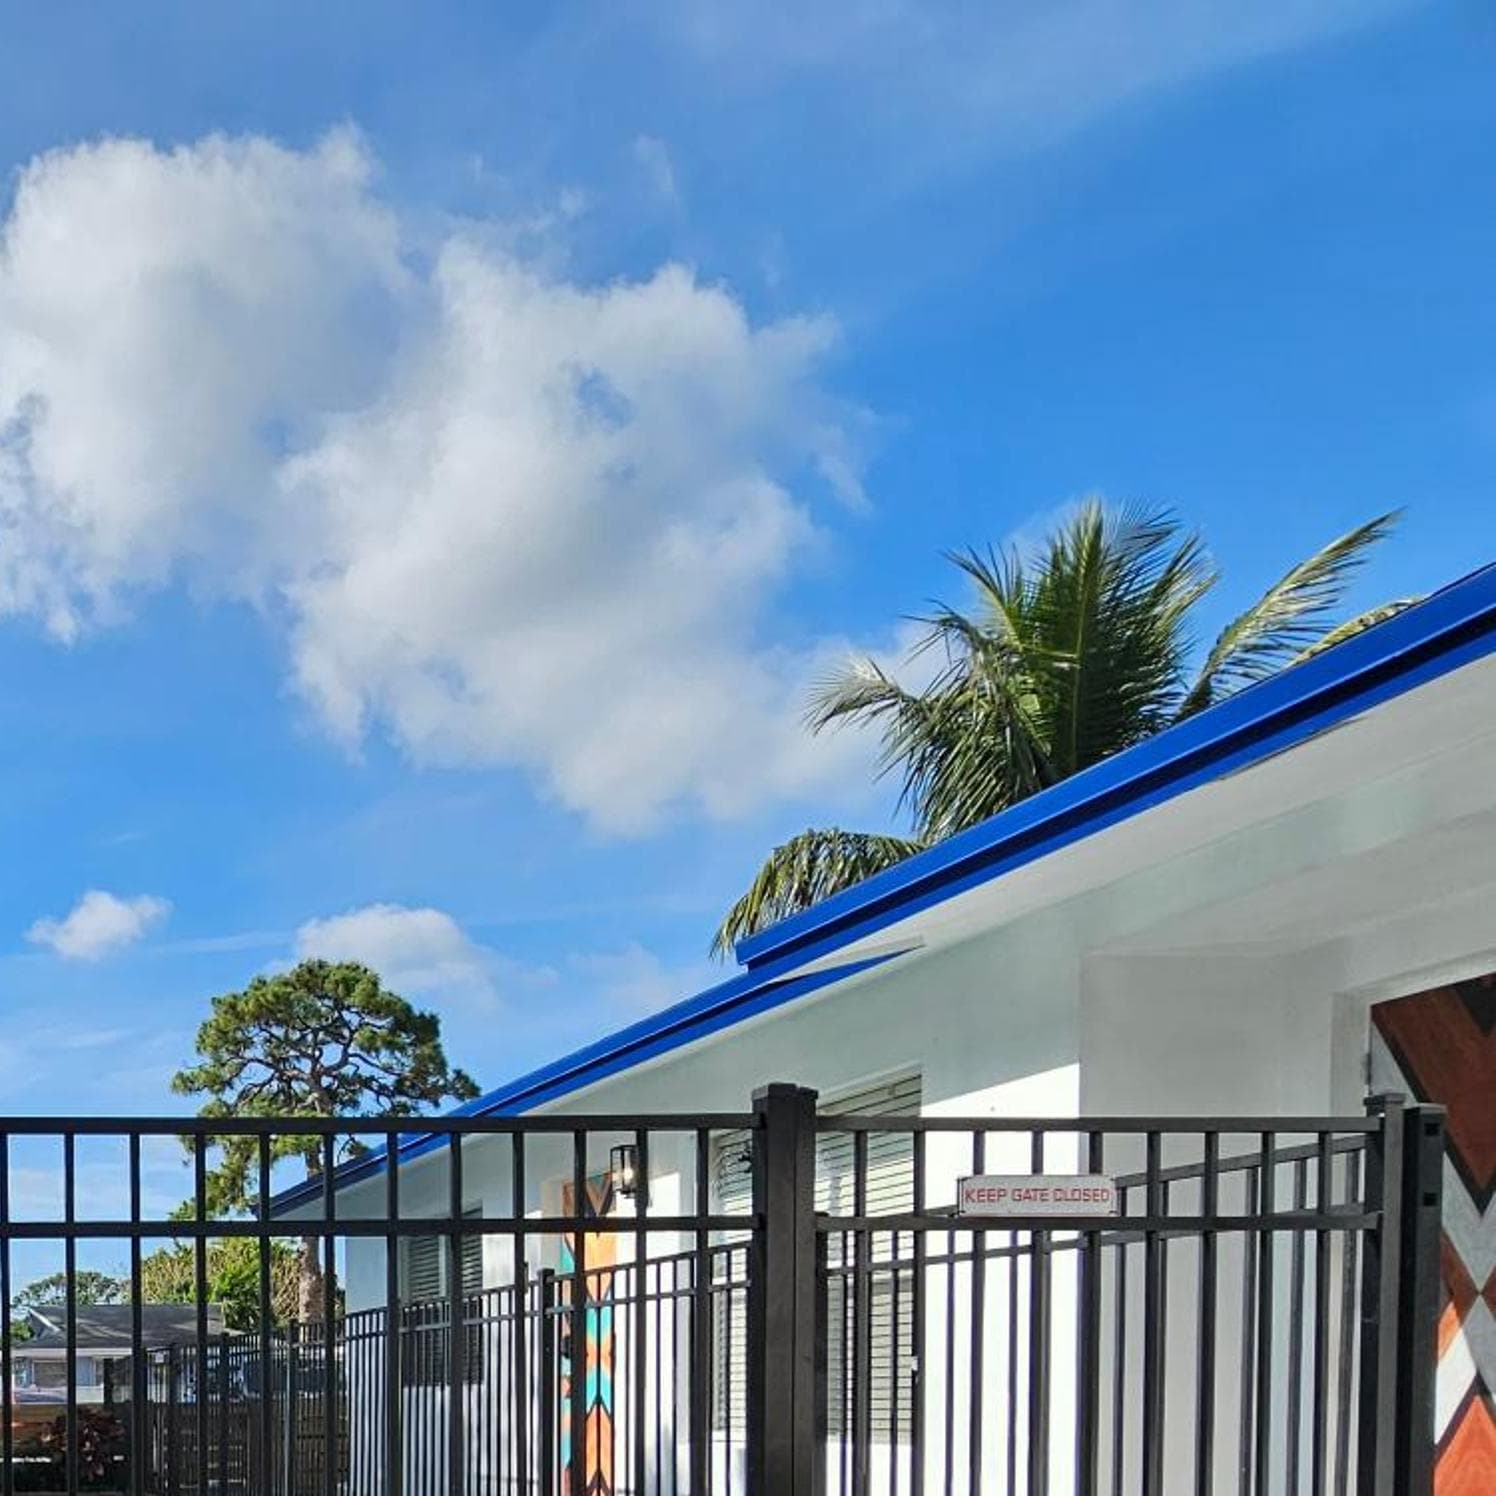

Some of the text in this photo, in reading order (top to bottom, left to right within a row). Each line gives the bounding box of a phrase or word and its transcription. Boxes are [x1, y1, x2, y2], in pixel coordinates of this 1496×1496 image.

[965, 1188, 1110, 1203] KEEP GATE CLOSED
